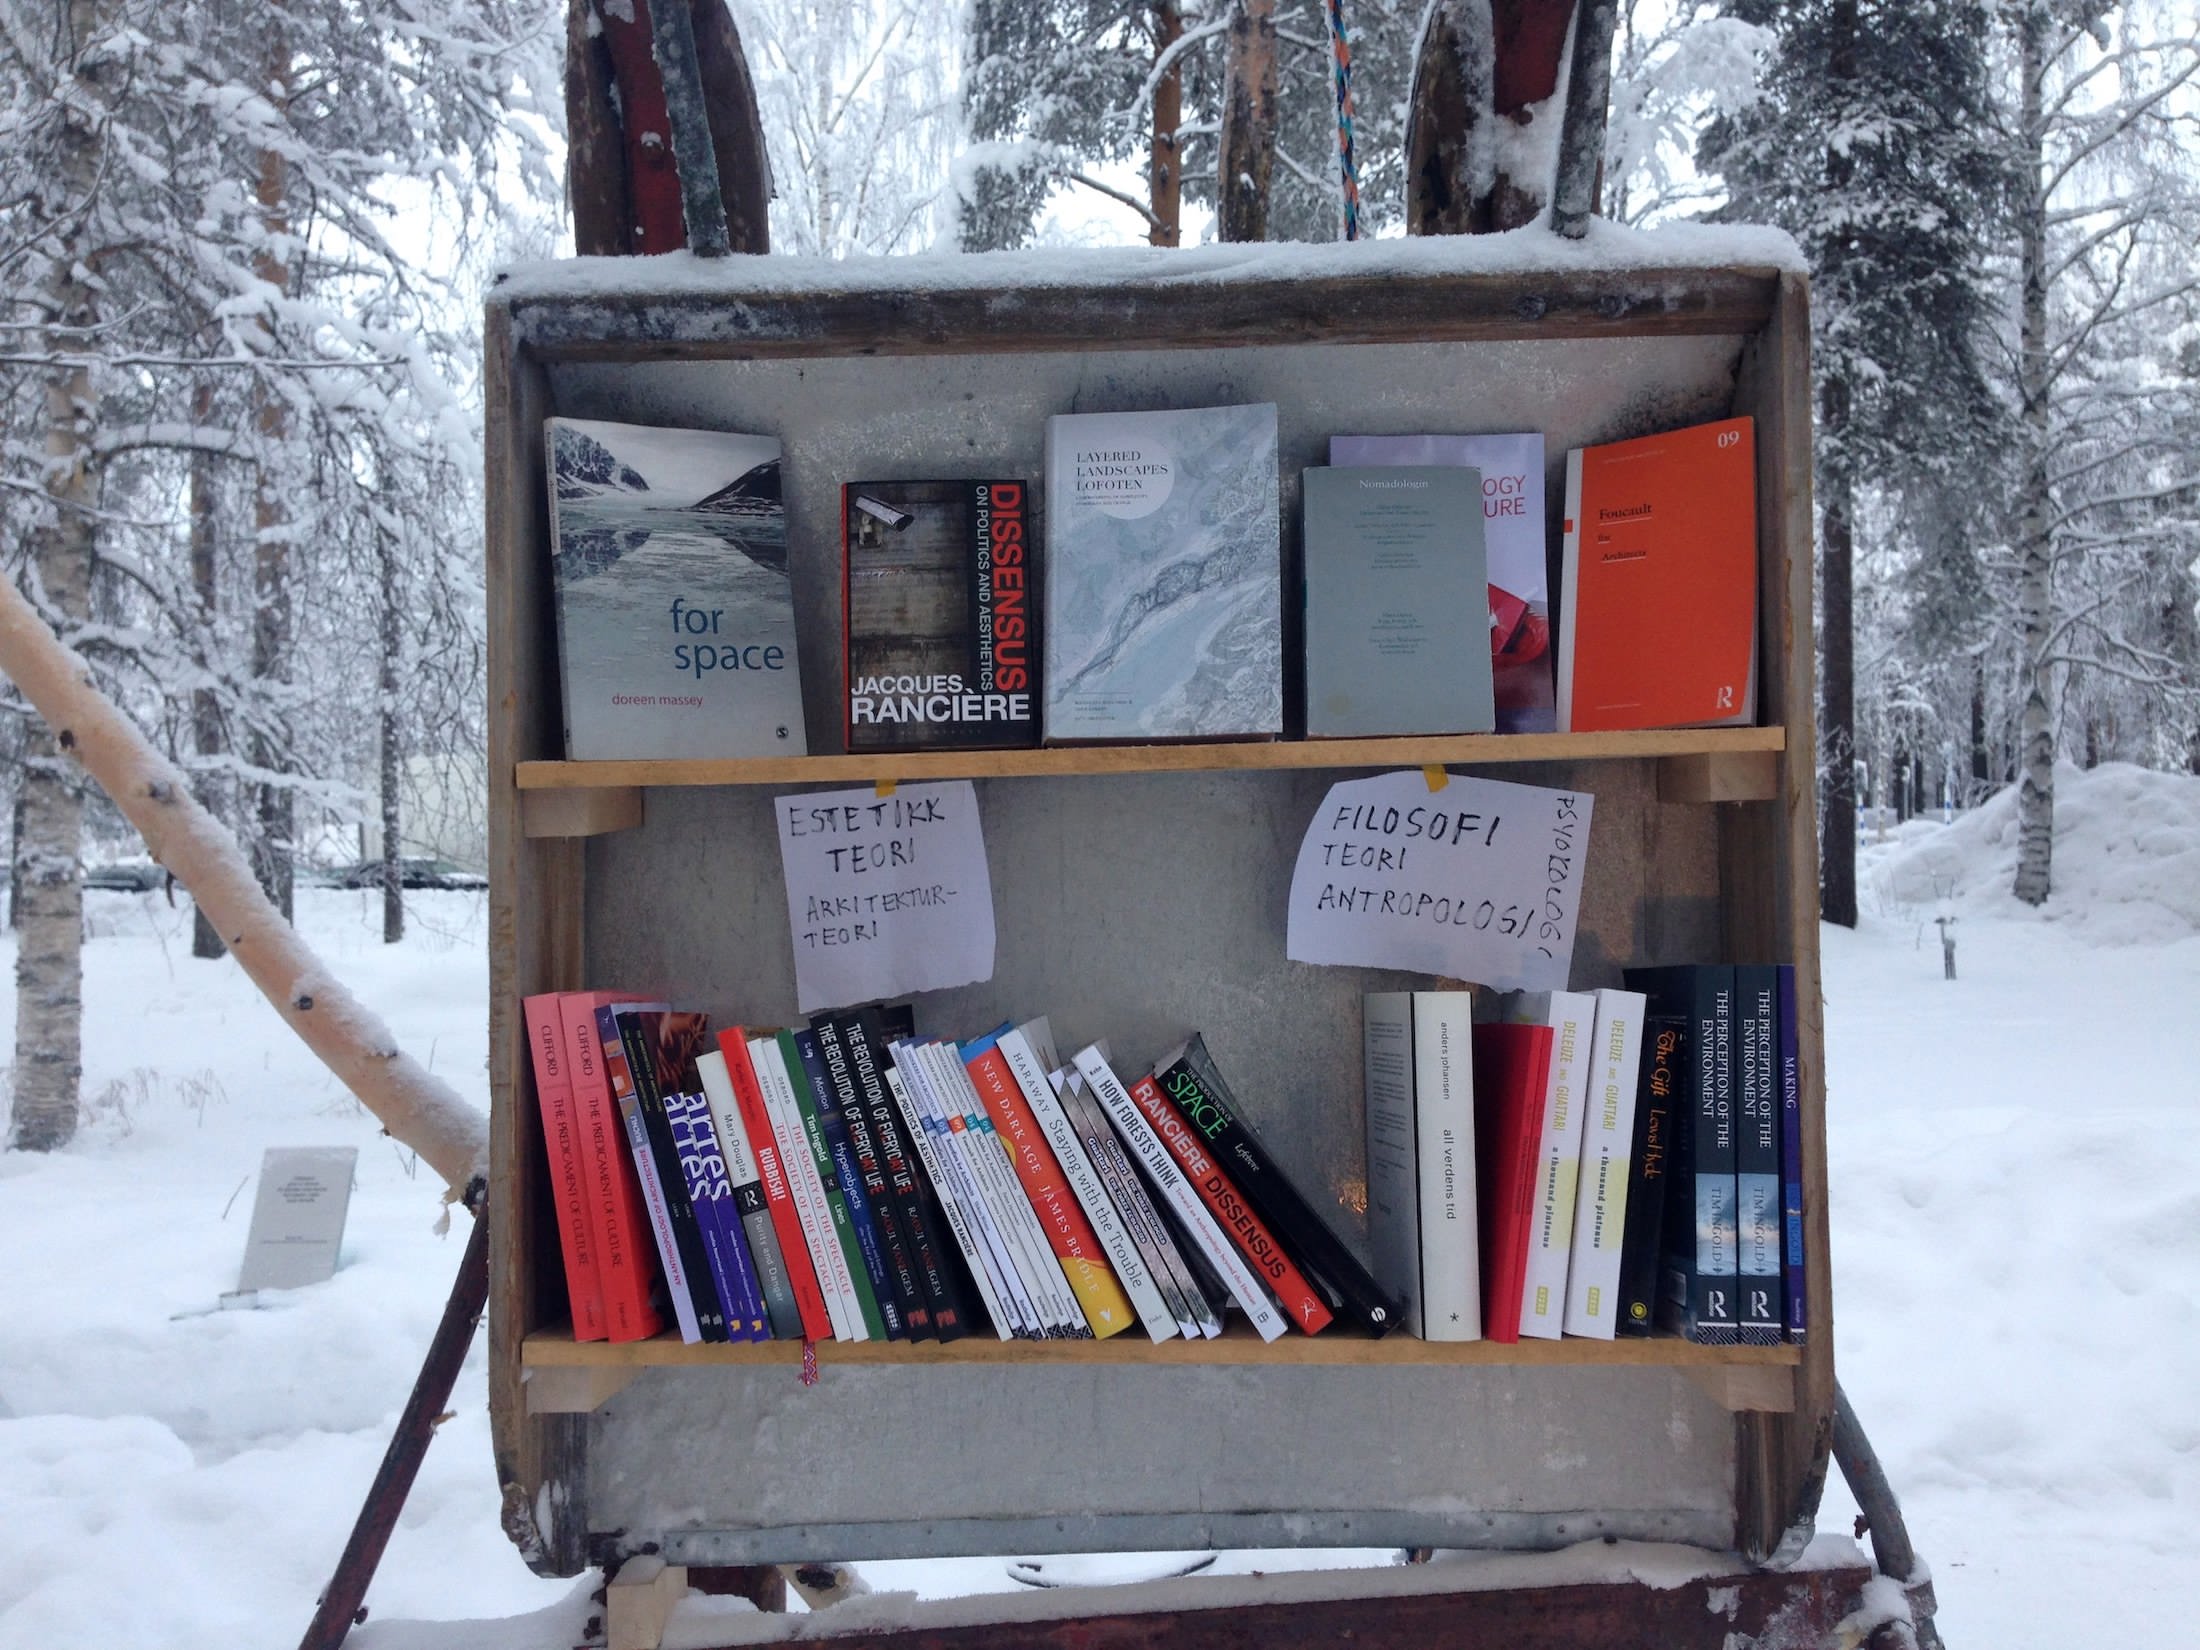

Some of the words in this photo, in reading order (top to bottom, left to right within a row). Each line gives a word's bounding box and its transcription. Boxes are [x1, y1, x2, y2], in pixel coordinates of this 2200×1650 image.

[1077, 451, 1141, 463] LAYERED
[1717, 431, 1739, 449] 09
[1077, 464, 1168, 477] LANDSCAPES
[1077, 479, 1143, 491] LOFOTEN
[975, 486, 988, 506] ON
[1599, 504, 1652, 520] Foucault
[976, 510, 990, 570] POLITICS
[978, 573, 990, 602] AND
[991, 484, 1027, 691] DISSENSUS
[670, 598, 724, 634] for
[674, 644, 785, 679] space
[979, 605, 993, 691] AESTHETICS
[612, 692, 656, 705] doreen
[659, 694, 703, 708] massey
[851, 674, 963, 696] JACQUES
[851, 687, 1030, 724] RANCIÈRE
[789, 797, 945, 837] ESTETIKK
[1333, 805, 1500, 847] FILOSOFI
[825, 838, 915, 873] TEORI
[1323, 843, 1406, 871] TEORI
[807, 884, 957, 923] ARKITEKTUR-
[803, 920, 878, 949] TEORI
[1716, 990, 1728, 1015] THE
[1758, 990, 1770, 1015] THE
[541, 1024, 558, 1076] CLIFFORD
[577, 1024, 593, 1076] CLIFFORD
[816, 1023, 837, 1045] THE
[844, 1023, 865, 1046] THE
[1440, 1021, 1449, 1054] anders
[1559, 1021, 1576, 1063] DELEUZE
[1608, 1020, 1625, 1062] DELEUZE
[1655, 1031, 1676, 1065] The
[823, 1043, 857, 1106] REVOLUTION
[851, 1043, 884, 1104] REVOLUTION
[1702, 1019, 1713, 1115] ENVIRONMENT
[1716, 1019, 1728, 1096] PERCEPTION
[1743, 1019, 1755, 1115] ENVIRONMENT
[1758, 1019, 1770, 1096] PERCEPTION
[814, 1076, 829, 1110] Morton
[893, 1082, 904, 1095] THE
[1013, 1052, 1050, 1112] HARAWAY
[1440, 1056, 1450, 1100] johansen
[1650, 1067, 1670, 1096] Gift
[1784, 1057, 1796, 1108] MAKING
[553, 1098, 566, 1117] THE
[588, 1098, 601, 1118] THE
[805, 1113, 818, 1131] Tim
[844, 1106, 862, 1120] OF
[872, 1106, 890, 1121] OF
[901, 1098, 919, 1130] POLITICS
[981, 1060, 1004, 1093] NEW
[999, 1098, 1025, 1140] DARK
[1020, 1144, 1042, 1174] AGE
[1167, 1072, 1227, 1139] SPACE
[1552, 1087, 1569, 1130] GUATTARI
[1602, 1084, 1618, 1130] GUATTARI
[1717, 1101, 1728, 1119] OF
[1759, 1101, 1770, 1119] OF
[682, 1093, 730, 1200] artes
[723, 1113, 735, 1137] Mary
[730, 1138, 747, 1178] Douglas
[791, 1124, 805, 1146] THE
[809, 1131, 827, 1162] Ingold
[851, 1121, 877, 1170] EVERYDAY
[879, 1121, 906, 1170] EVERYDAY
[914, 1130, 924, 1140] OF
[1099, 1079, 1124, 1107] HOW
[1117, 1105, 1155, 1154] FORESTS
[1149, 1151, 1178, 1188] THINK
[1136, 1083, 1208, 1175] RANCIÈRE
[1442, 1128, 1453, 1144] all
[1717, 1122, 1728, 1147] THE
[1759, 1123, 1770, 1147] THE
[558, 1121, 577, 1196] PREDICAMENT
[592, 1122, 612, 1197] PREDICAMENT
[799, 1148, 819, 1193] SOCIETY
[918, 1142, 943, 1185] AESTHETICS
[1086, 1135, 1112, 1175] Guattari
[1106, 1139, 1129, 1177] Guattari
[1443, 1148, 1455, 1199] verdens
[639, 1149, 658, 1202] ARCHITECTURE
[757, 1148, 786, 1202] RUBBISH!
[835, 1142, 861, 1209] Hyperobjects
[864, 1170, 886, 1195] LIFE
[892, 1170, 914, 1196] LIFE
[1547, 1156, 1559, 1201] thousand
[1597, 1155, 1609, 1201] thousand
[570, 1199, 580, 1214] OF
[604, 1200, 615, 1214] OF
[653, 1203, 662, 1215] OF
[775, 1124, 788, 1145] THE
[782, 1148, 802, 1192] SOCIETY
[797, 1195, 808, 1209] OF
[803, 1213, 815, 1233] THE
[810, 1237, 834, 1293] SPECTACLE
[814, 1195, 825, 1209] OF
[833, 1203, 846, 1224] Lines
[1049, 1119, 1081, 1174] Staying
[1077, 1173, 1100, 1206] with
[1094, 1206, 1113, 1232] the
[1109, 1231, 1142, 1288] Trouble
[1445, 1203, 1456, 1219] tid
[1711, 1187, 1722, 1211] TIM
[1753, 1187, 1764, 1211] TIM
[573, 1218, 588, 1264] CULTURE
[607, 1218, 622, 1266] CULTURE
[819, 1213, 832, 1234] THE
[1038, 1185, 1071, 1233] JAMES
[1065, 1236, 1100, 1294] BRIDLE
[1205, 1176, 1285, 1278] DISSENSUS
[1542, 1205, 1554, 1248] plateaus
[1593, 1204, 1604, 1248] plateaus
[1711, 1211, 1722, 1262] INGOLD
[1754, 1211, 1765, 1262] INGOLD
[656, 1214, 679, 1274] ANTHROPOLOGY
[827, 1237, 851, 1294] SPECTACLE
